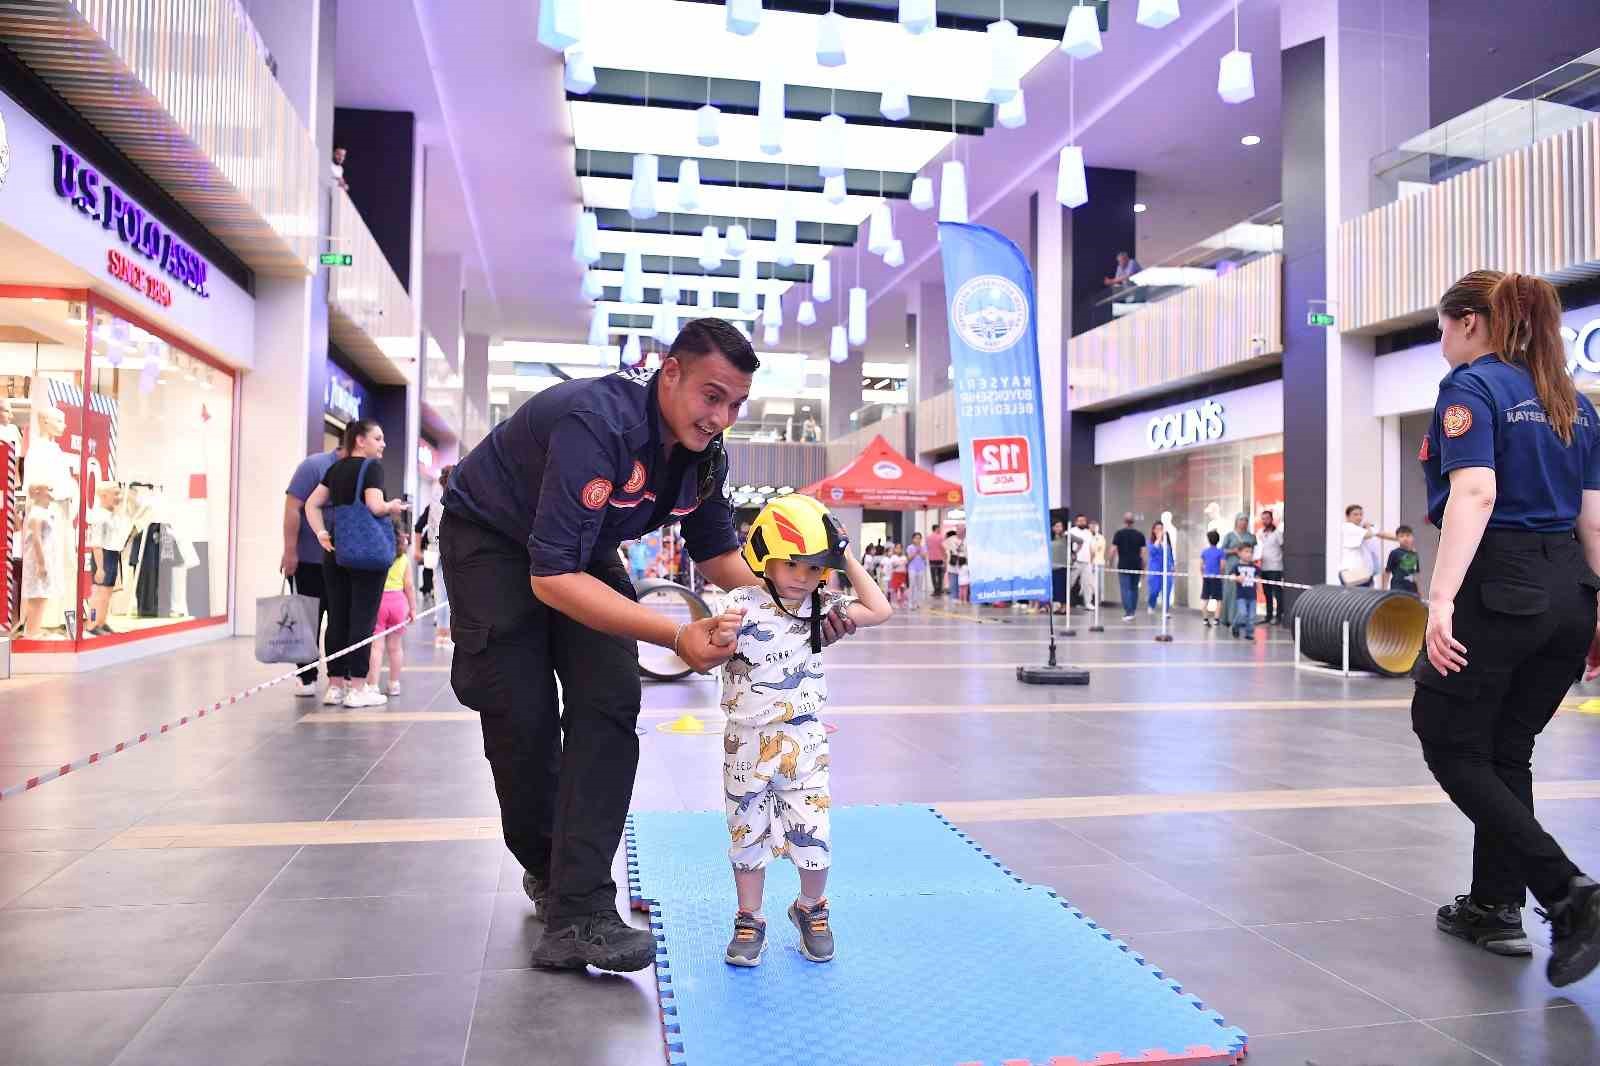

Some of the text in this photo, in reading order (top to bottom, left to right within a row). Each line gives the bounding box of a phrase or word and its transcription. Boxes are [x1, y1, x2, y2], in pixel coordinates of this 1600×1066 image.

[52, 144, 101, 221] U.S.
[102, 186, 160, 260] POLO
[107, 249, 173, 307] SINCE 1890
[1147, 399, 1225, 450] COLIN'S
